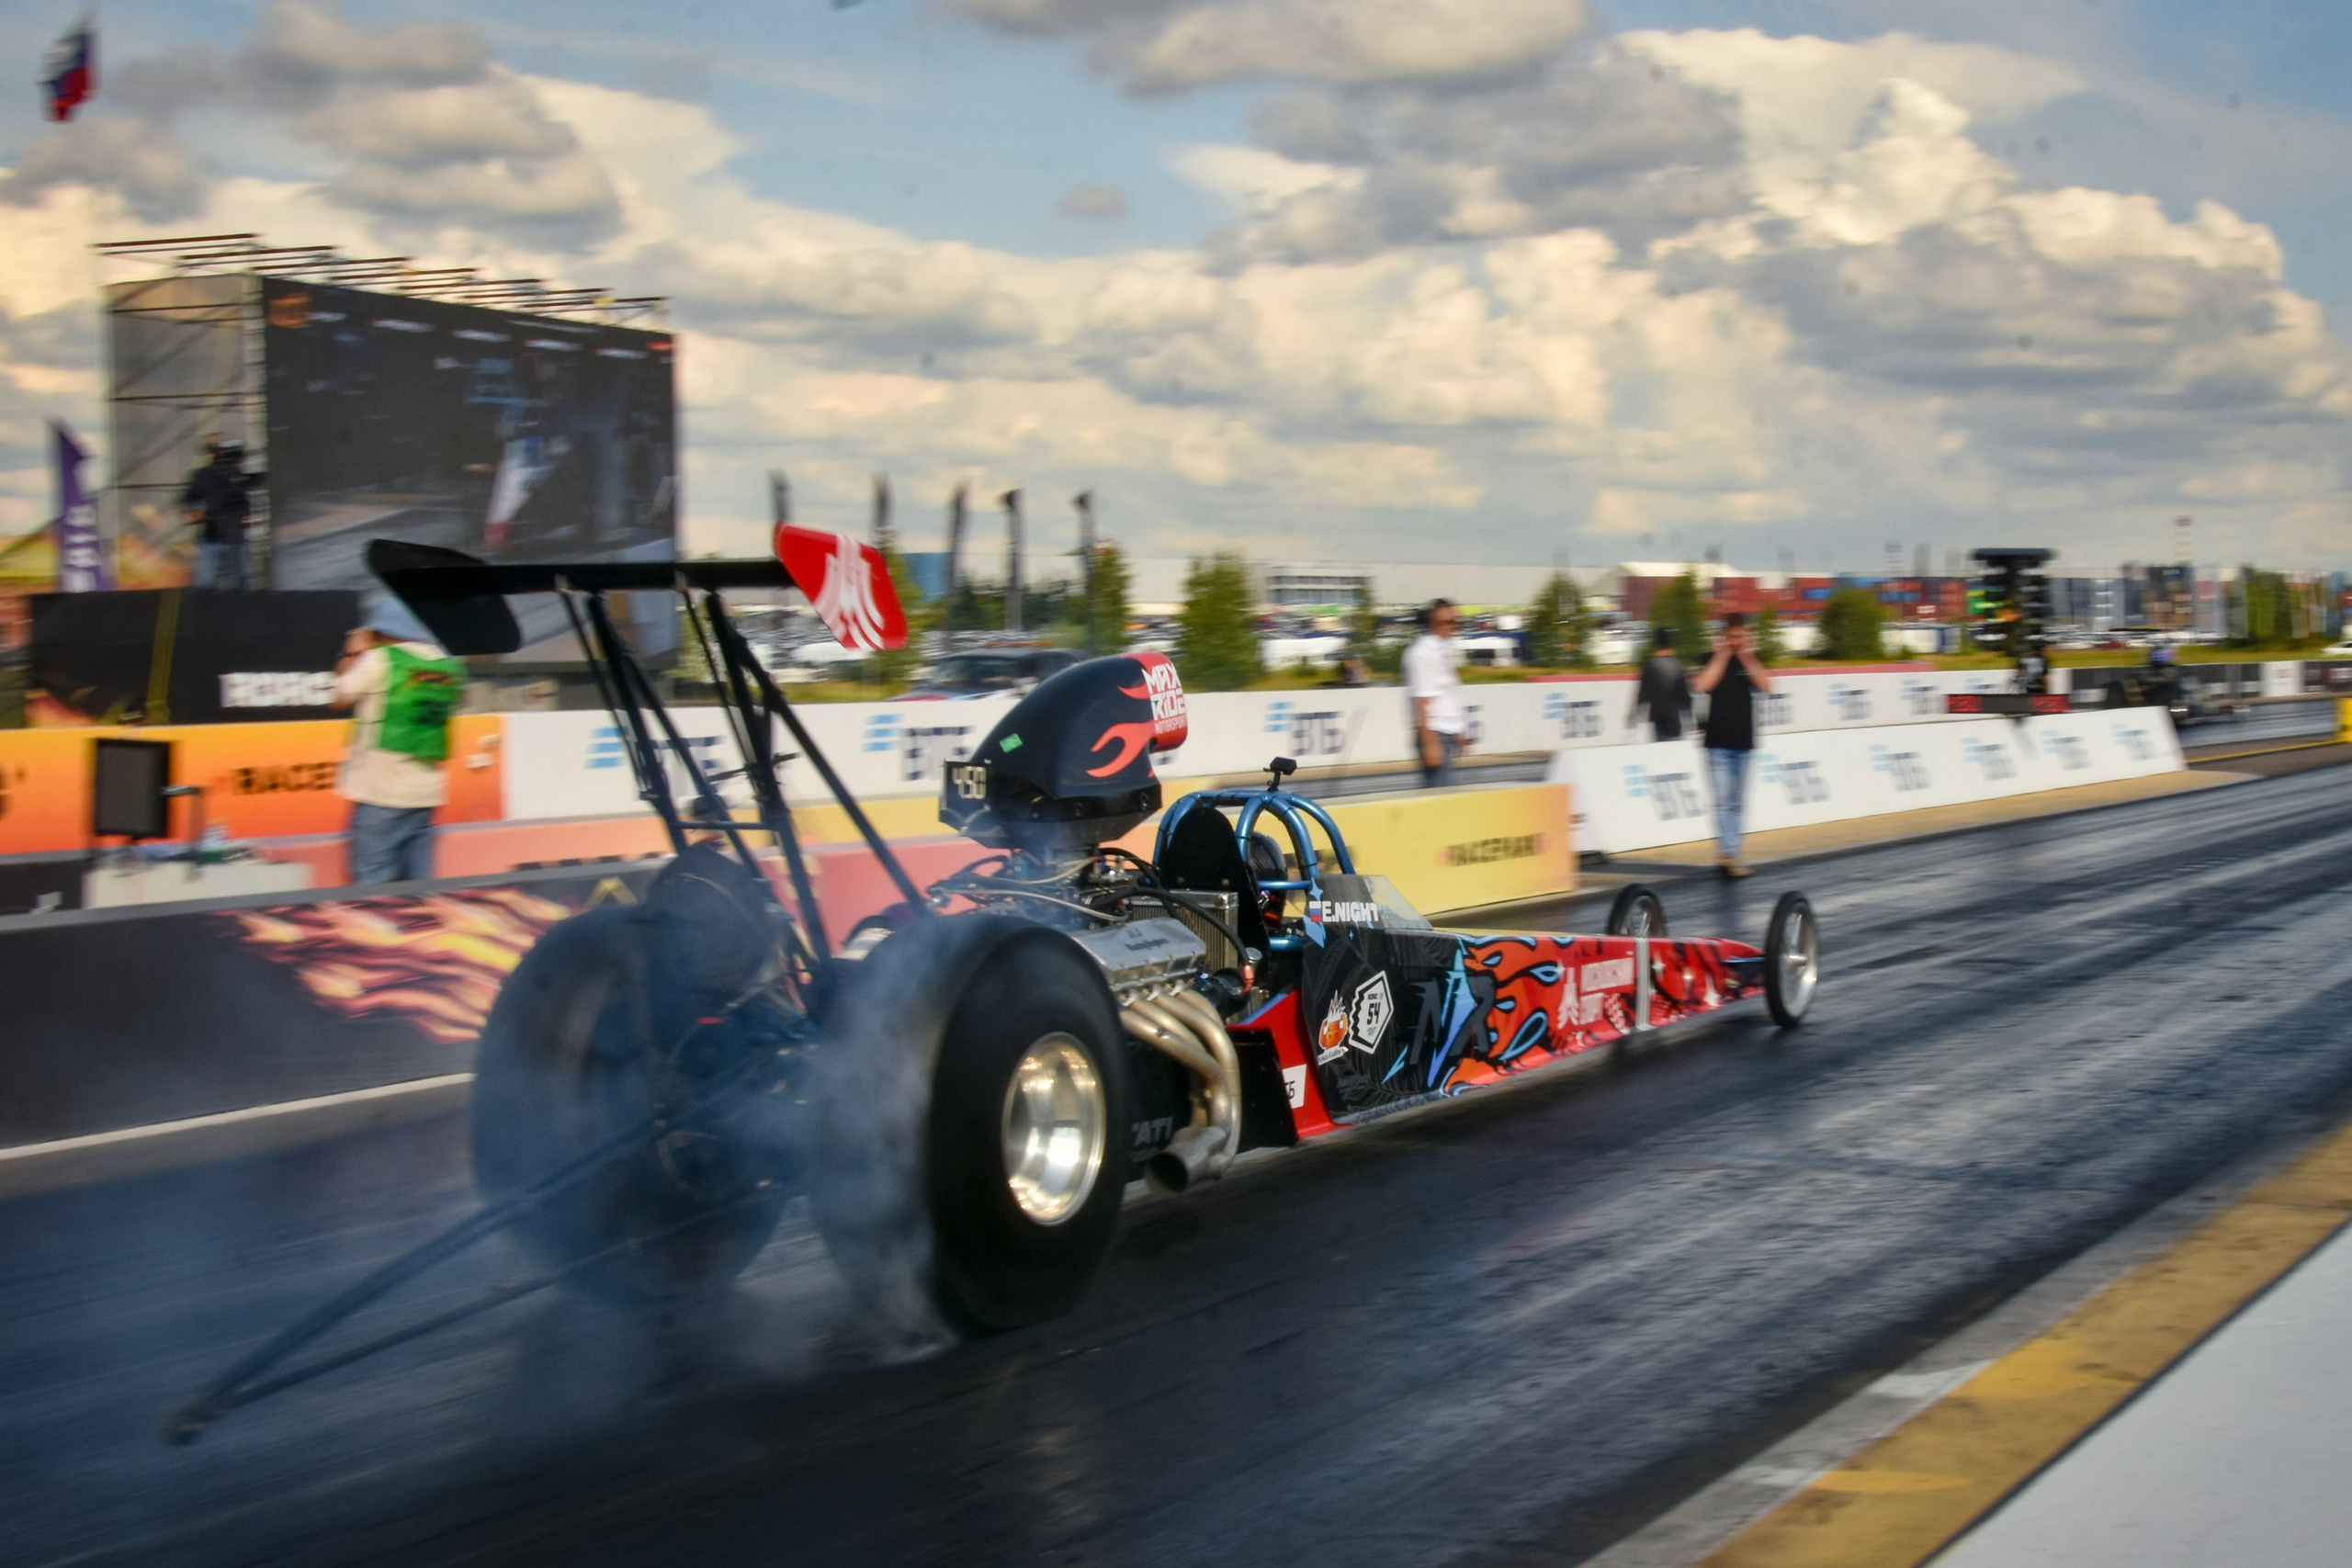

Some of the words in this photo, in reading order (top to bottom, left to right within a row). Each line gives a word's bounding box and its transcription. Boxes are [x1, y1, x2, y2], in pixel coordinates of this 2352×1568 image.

[1142, 663, 1182, 695] MAX
[1323, 901, 1379, 922] E.NIGHT
[1366, 1002, 1381, 1025] 54
